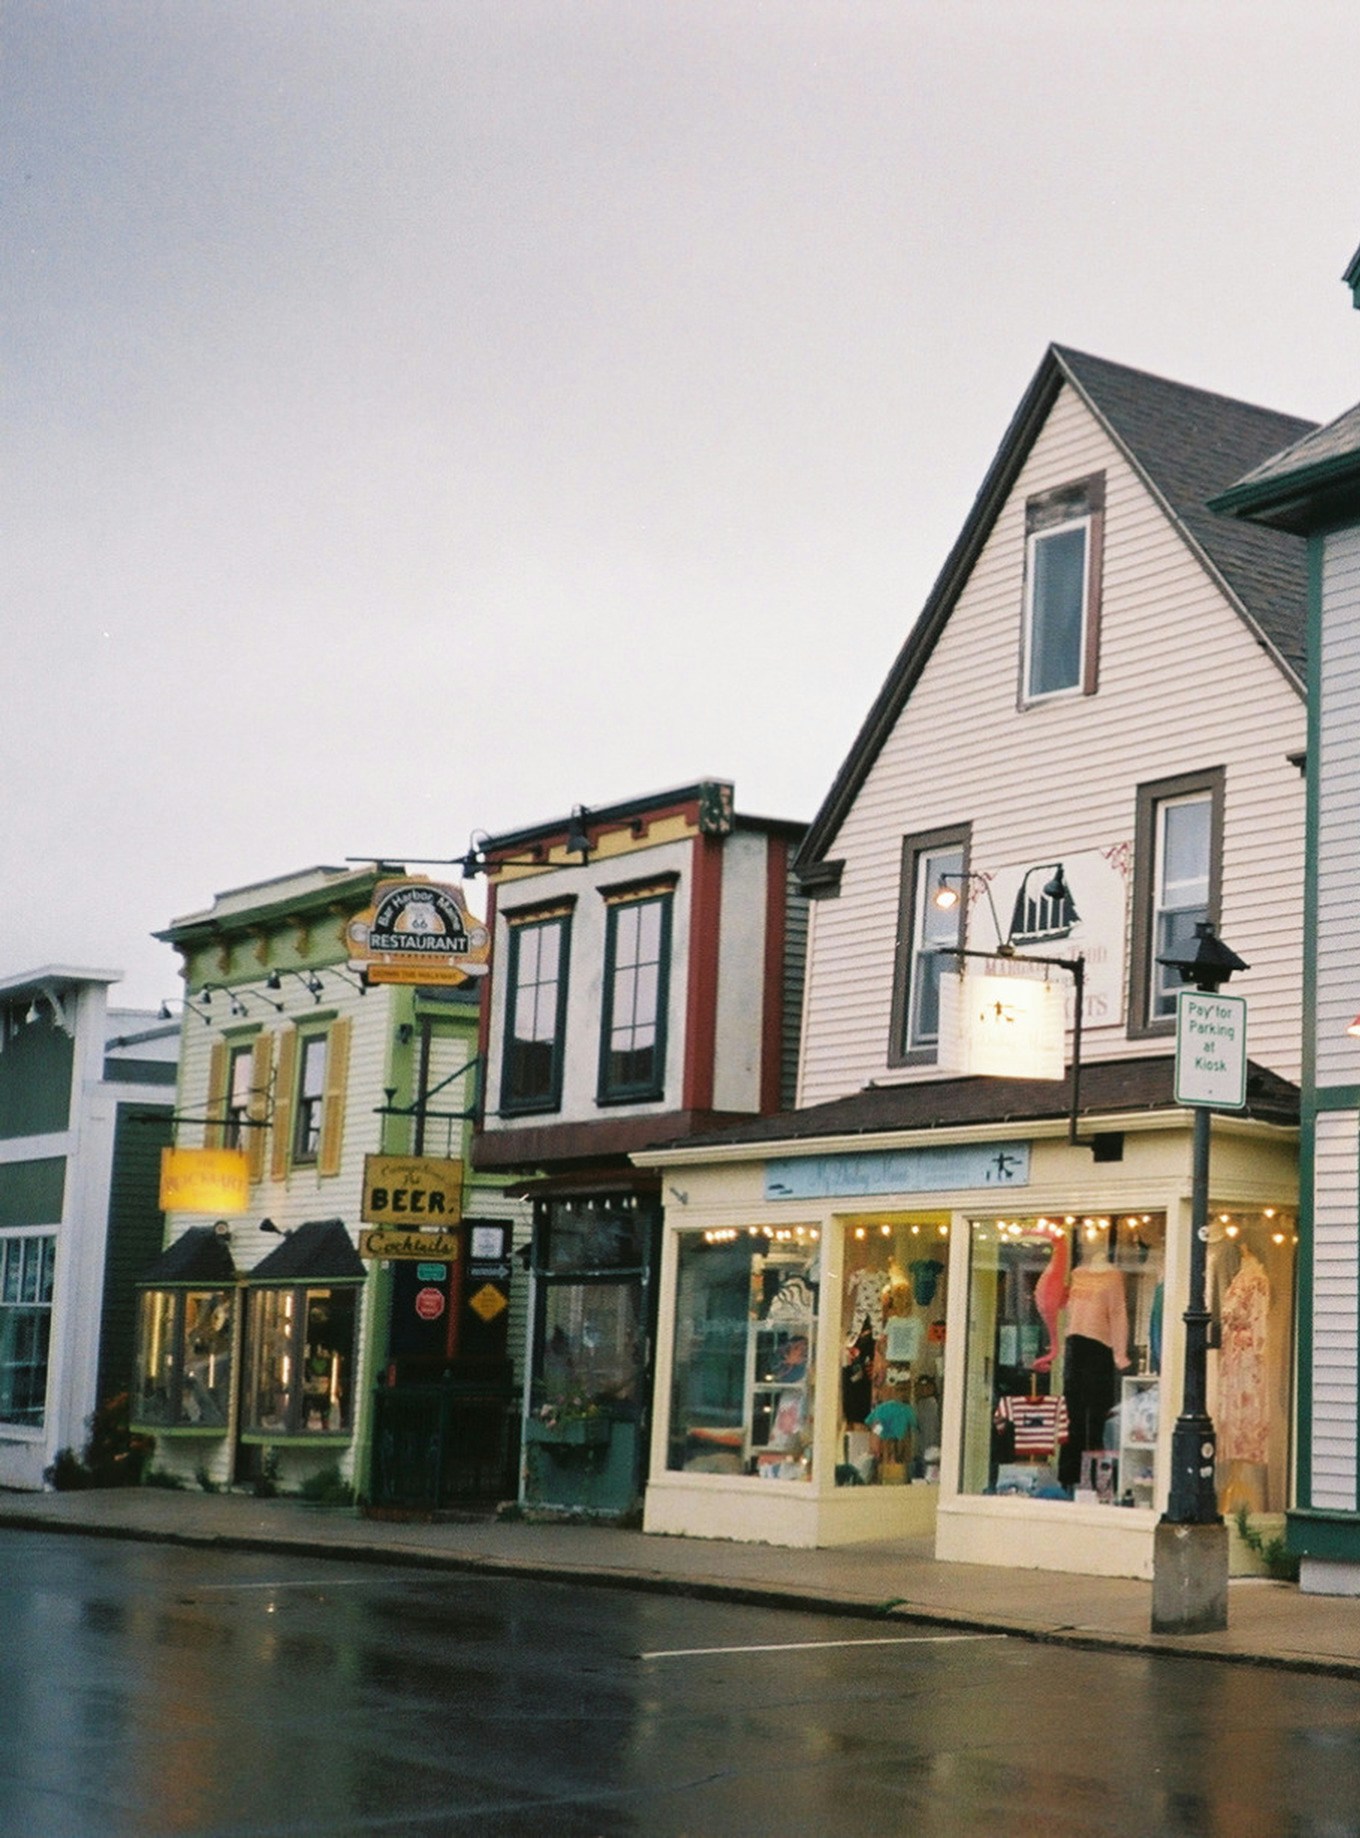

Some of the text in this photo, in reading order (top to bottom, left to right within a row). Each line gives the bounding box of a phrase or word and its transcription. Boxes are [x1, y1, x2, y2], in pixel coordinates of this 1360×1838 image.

[378, 905, 394, 928] Bar
[411, 919, 429, 930] 66
[371, 933, 467, 951] RESTAURANT
[1188, 1001, 1232, 1019] Pay for
[1189, 1020, 1235, 1041] Parking
[1203, 1042, 1215, 1053] at
[1194, 1057, 1227, 1072] Kiosk
[366, 1232, 456, 1255] Cocktails
